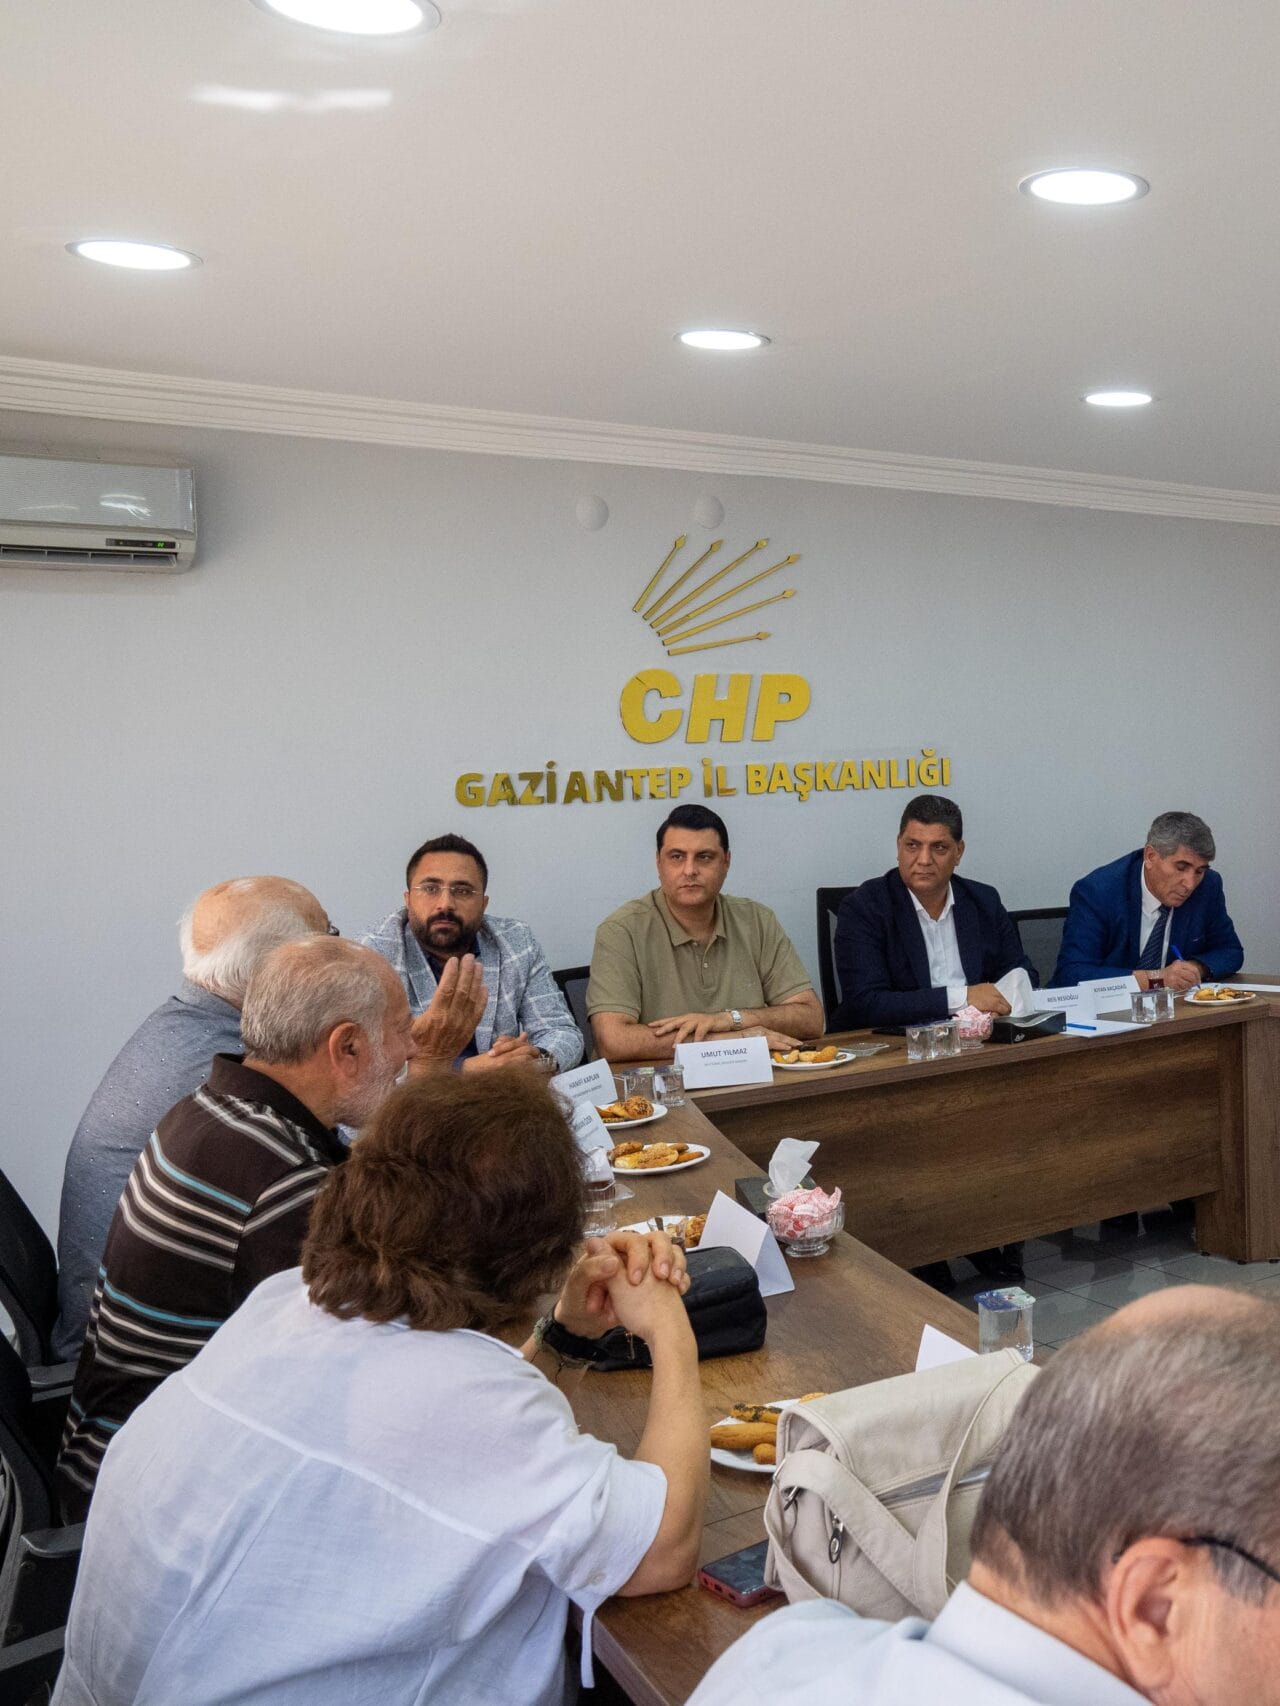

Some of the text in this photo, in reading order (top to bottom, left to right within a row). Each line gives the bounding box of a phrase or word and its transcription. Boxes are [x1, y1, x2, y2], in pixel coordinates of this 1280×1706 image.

[620, 668, 811, 744] CHP
[455, 749, 952, 806] GAZİANTEP İL BAŞKANLIĞI
[701, 1050, 722, 1058] UMUT
